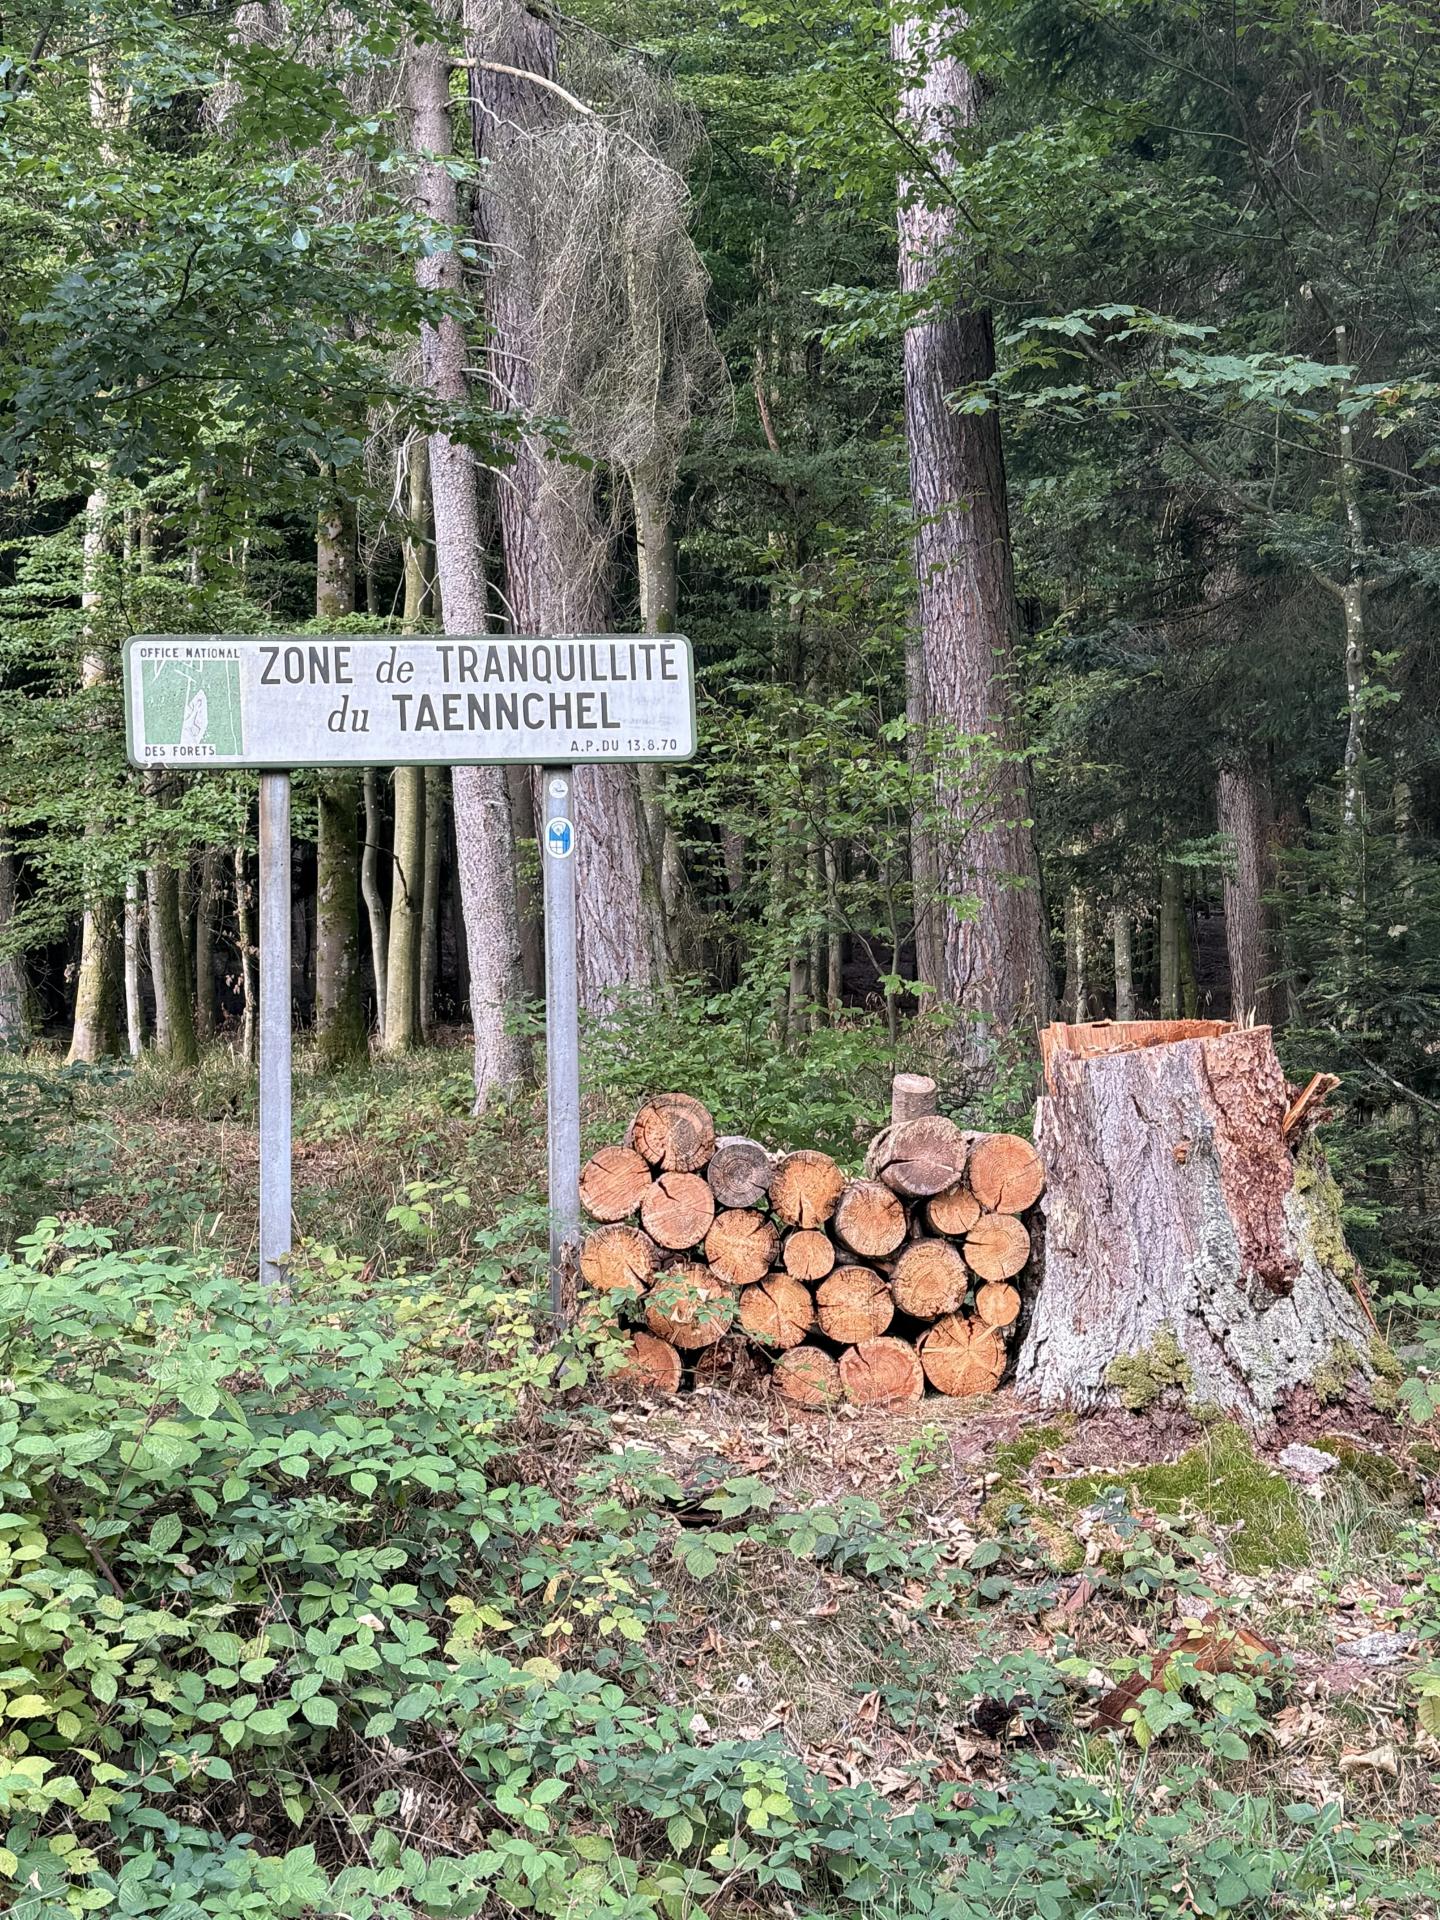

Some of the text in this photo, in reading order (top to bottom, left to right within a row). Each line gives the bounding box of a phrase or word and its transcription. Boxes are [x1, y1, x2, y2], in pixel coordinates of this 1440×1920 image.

[140, 648, 240, 659] OFFICE NATIONAL
[259, 644, 678, 685] ZONE de TRANQUILLITE
[328, 692, 621, 732] du TAENNCHEL
[145, 746, 215, 757] DES FORETS
[627, 739, 677, 752] 13.8.70
